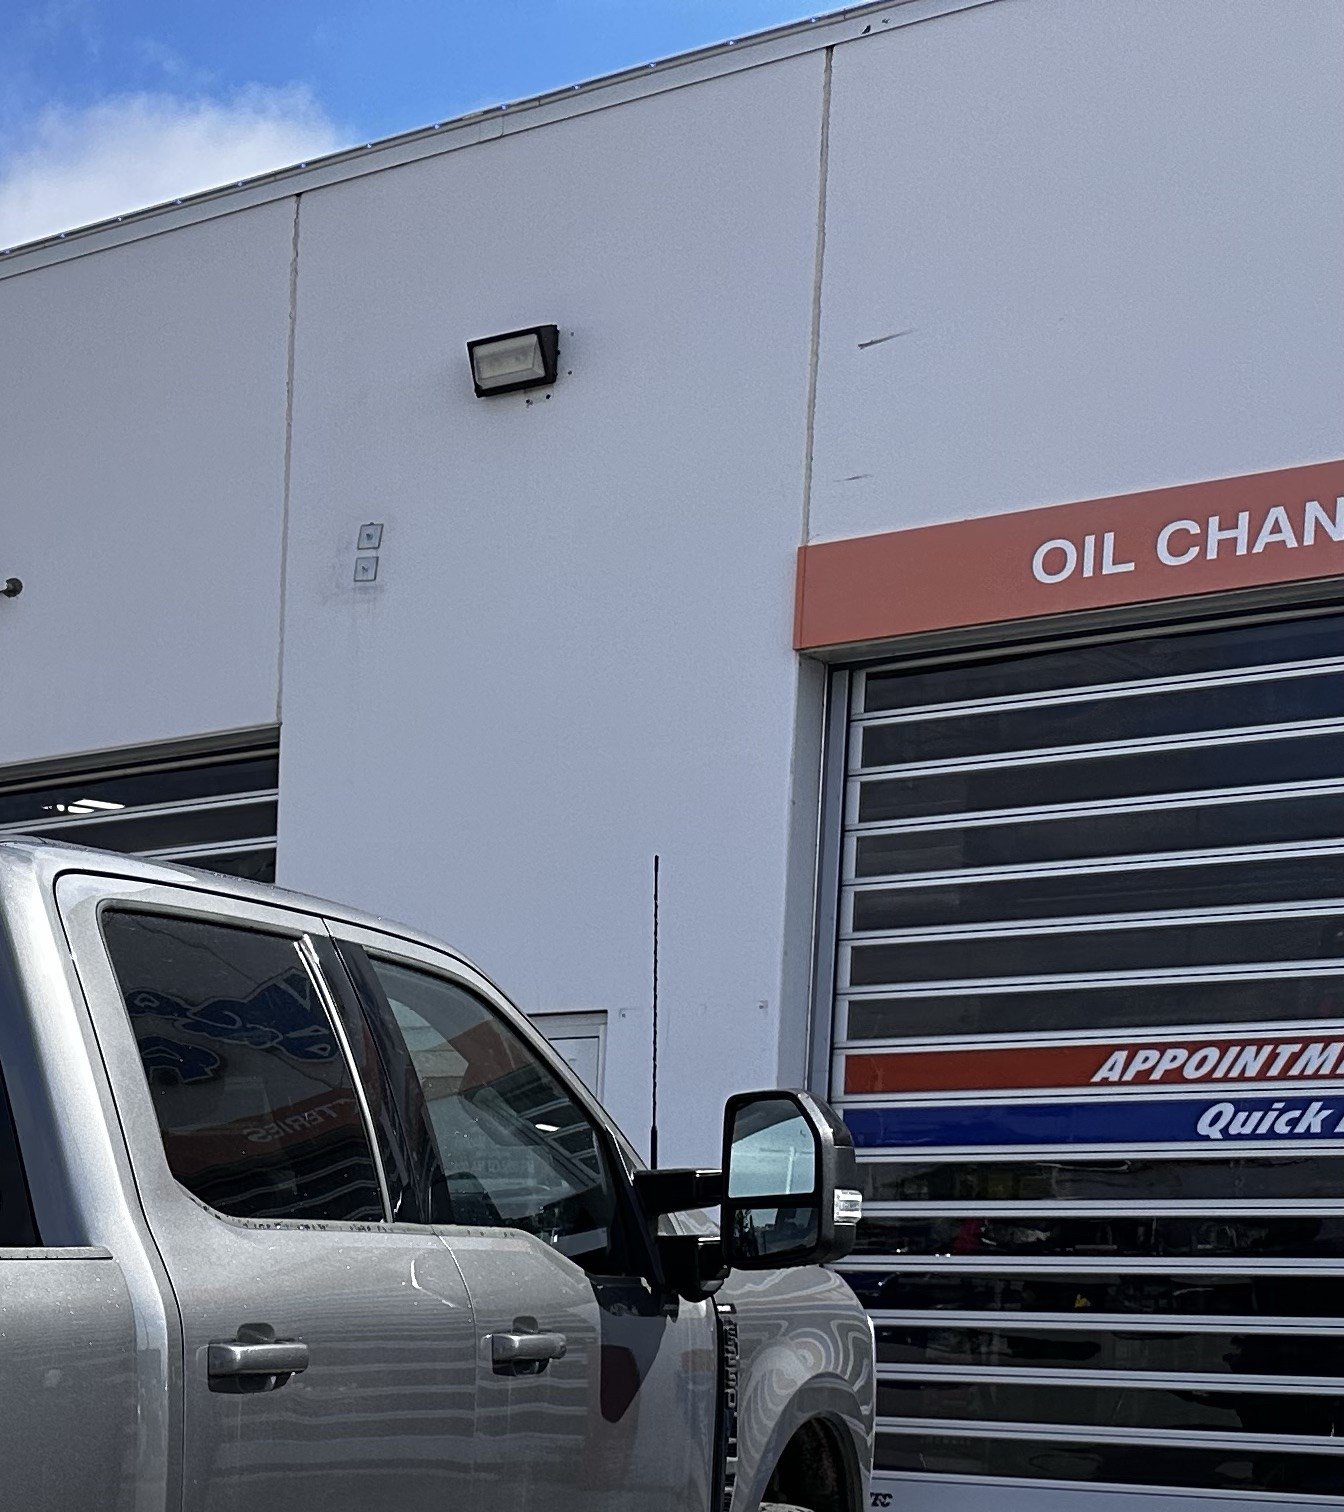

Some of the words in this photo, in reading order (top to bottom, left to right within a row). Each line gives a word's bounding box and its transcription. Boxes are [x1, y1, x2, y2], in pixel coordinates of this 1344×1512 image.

[1032, 532, 1135, 584] OIL
[1090, 1042, 1344, 1083] APPOINTM
[1196, 1101, 1334, 1139] Quick
